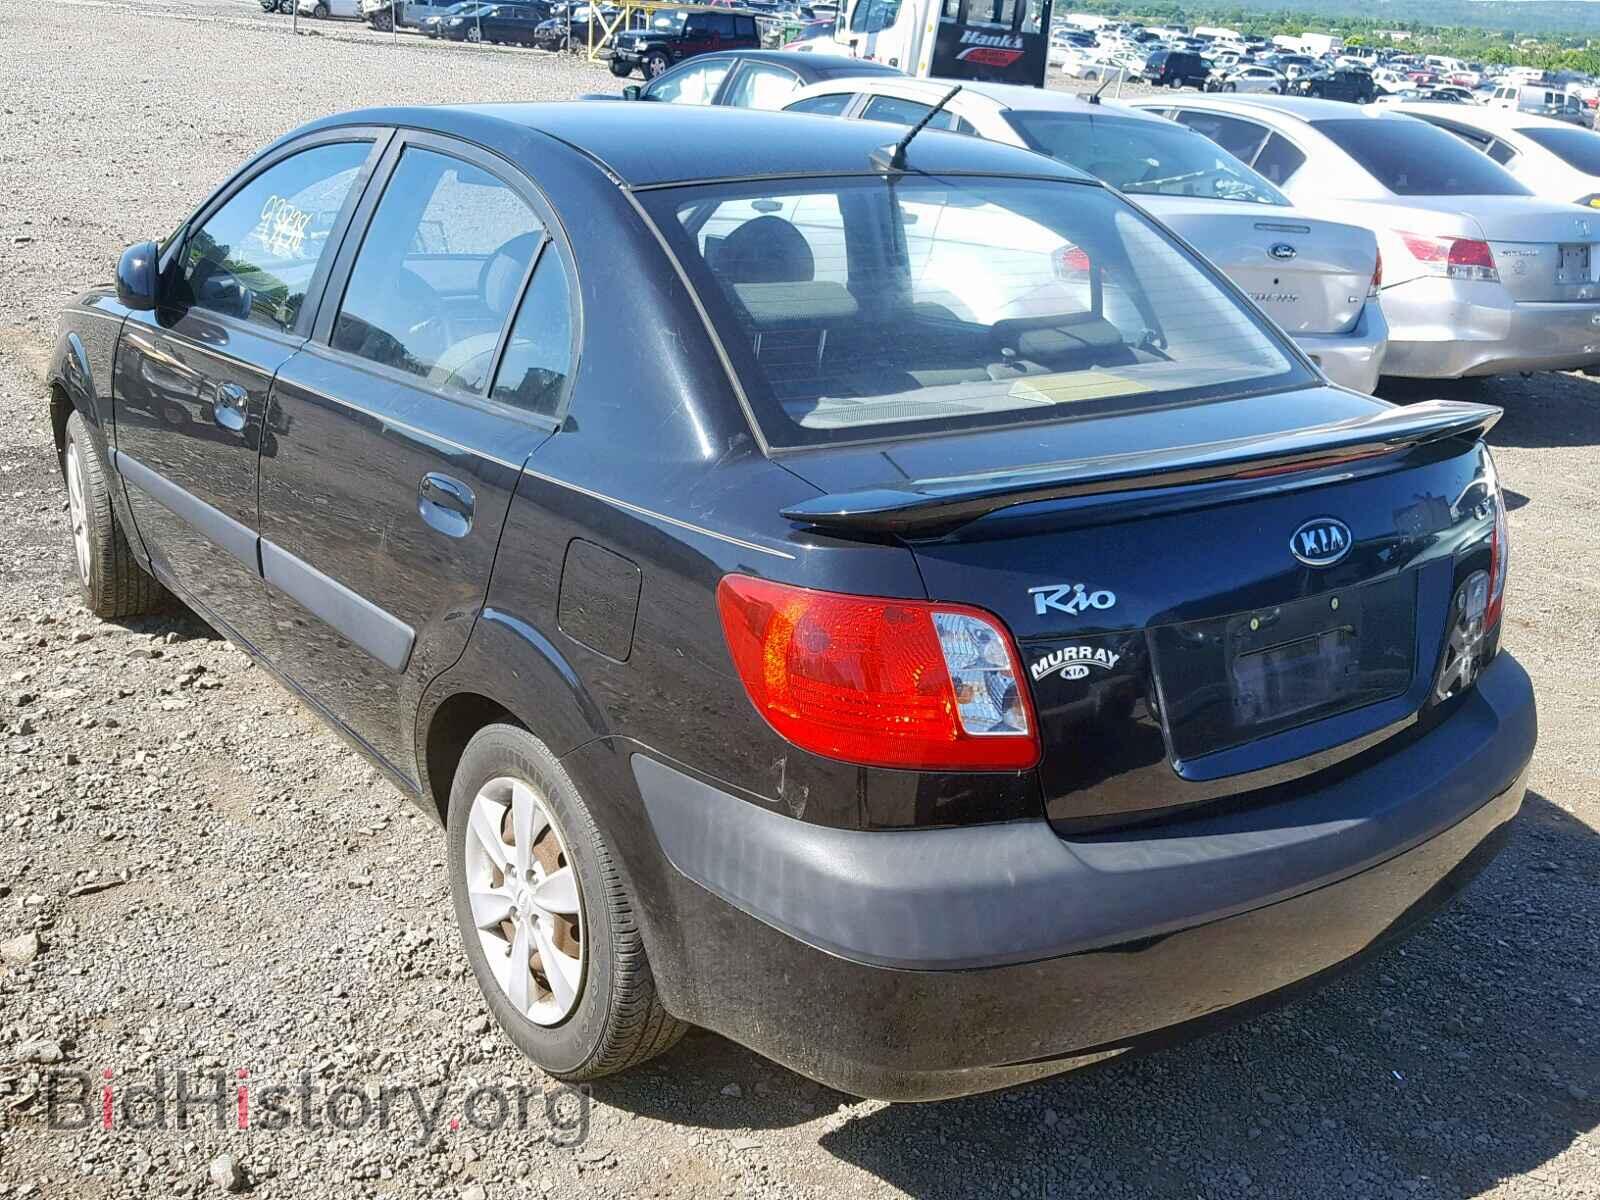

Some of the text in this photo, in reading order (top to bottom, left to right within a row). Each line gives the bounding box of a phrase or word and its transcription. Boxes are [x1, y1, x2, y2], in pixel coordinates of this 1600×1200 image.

[1300, 526, 1344, 557] KIA
[1028, 584, 1116, 616] Rio
[1031, 646, 1120, 681] MURRAY
[1063, 667, 1086, 678] KIA
